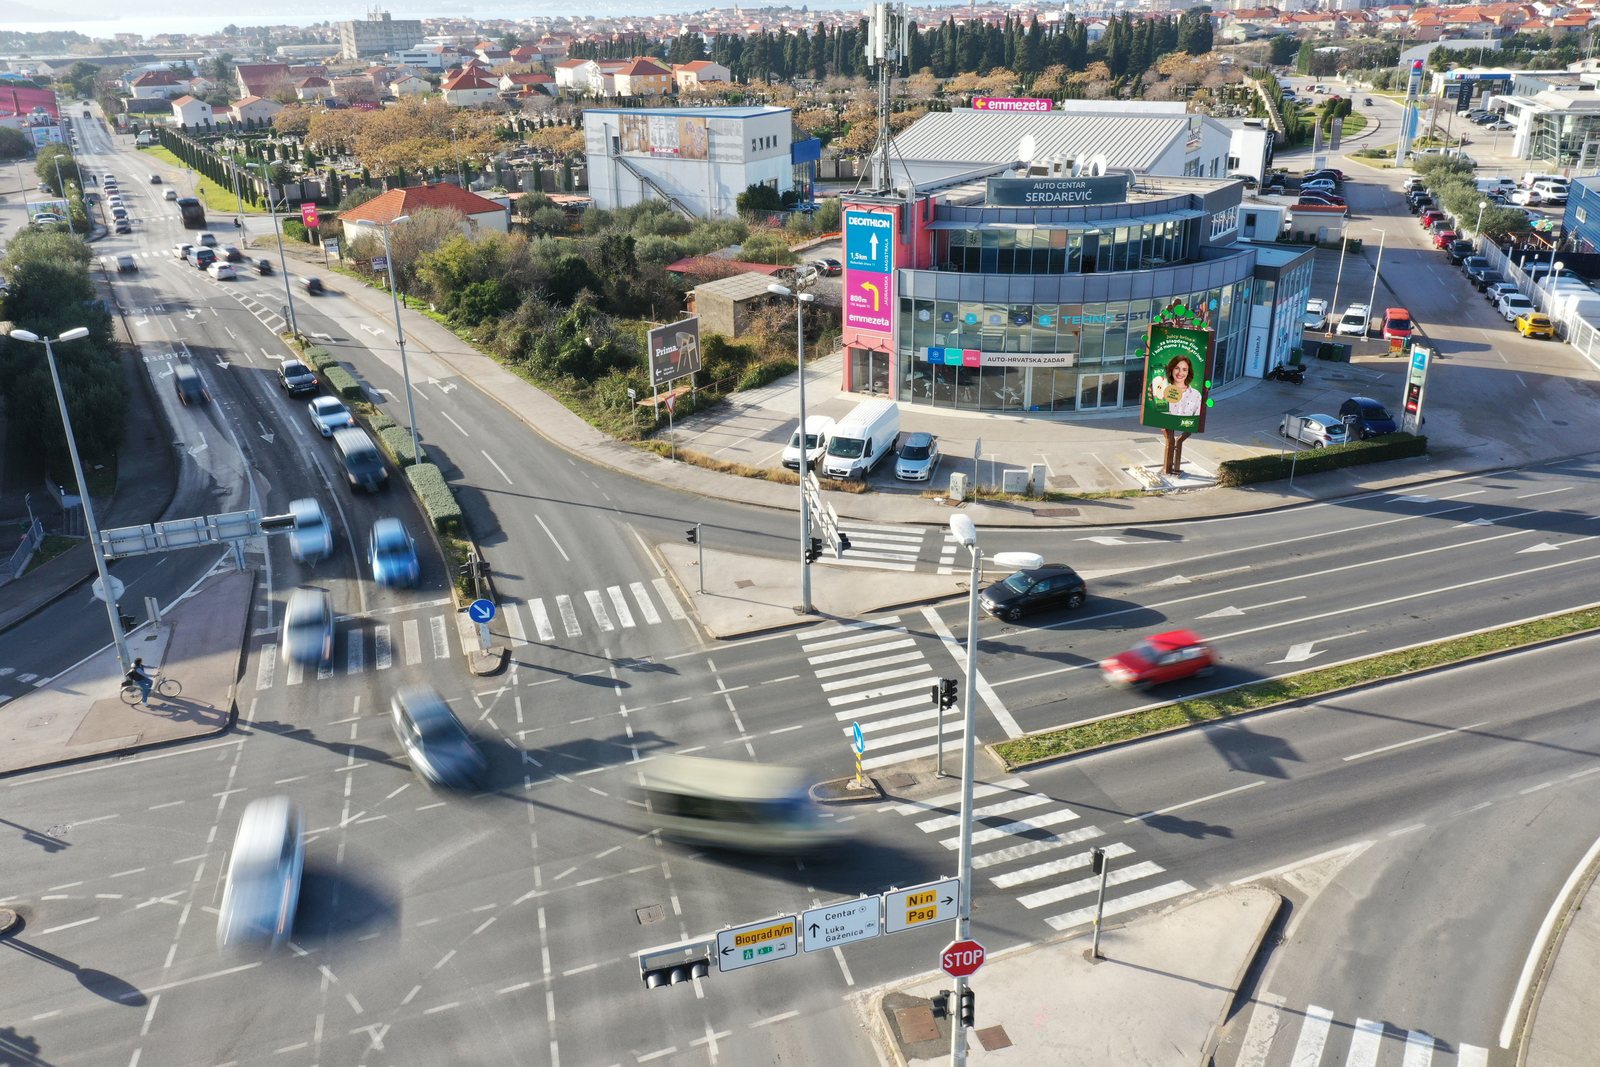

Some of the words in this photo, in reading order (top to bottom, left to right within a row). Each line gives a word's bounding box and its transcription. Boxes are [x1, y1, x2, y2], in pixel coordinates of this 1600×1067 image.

[988, 100, 1047, 110] emmezeta
[1025, 189, 1092, 202] SERDAREVIĆ
[848, 314, 890, 327] emmezeta
[987, 356, 1042, 364] AUTO-HRVATSKA
[909, 894, 933, 907] Nin
[825, 909, 856, 921] Centar
[908, 909, 934, 922] Pag
[735, 929, 772, 945] Biograd
[774, 925, 793, 937] n/m
[825, 925, 845, 935] Luka
[943, 949, 983, 969] STOP
